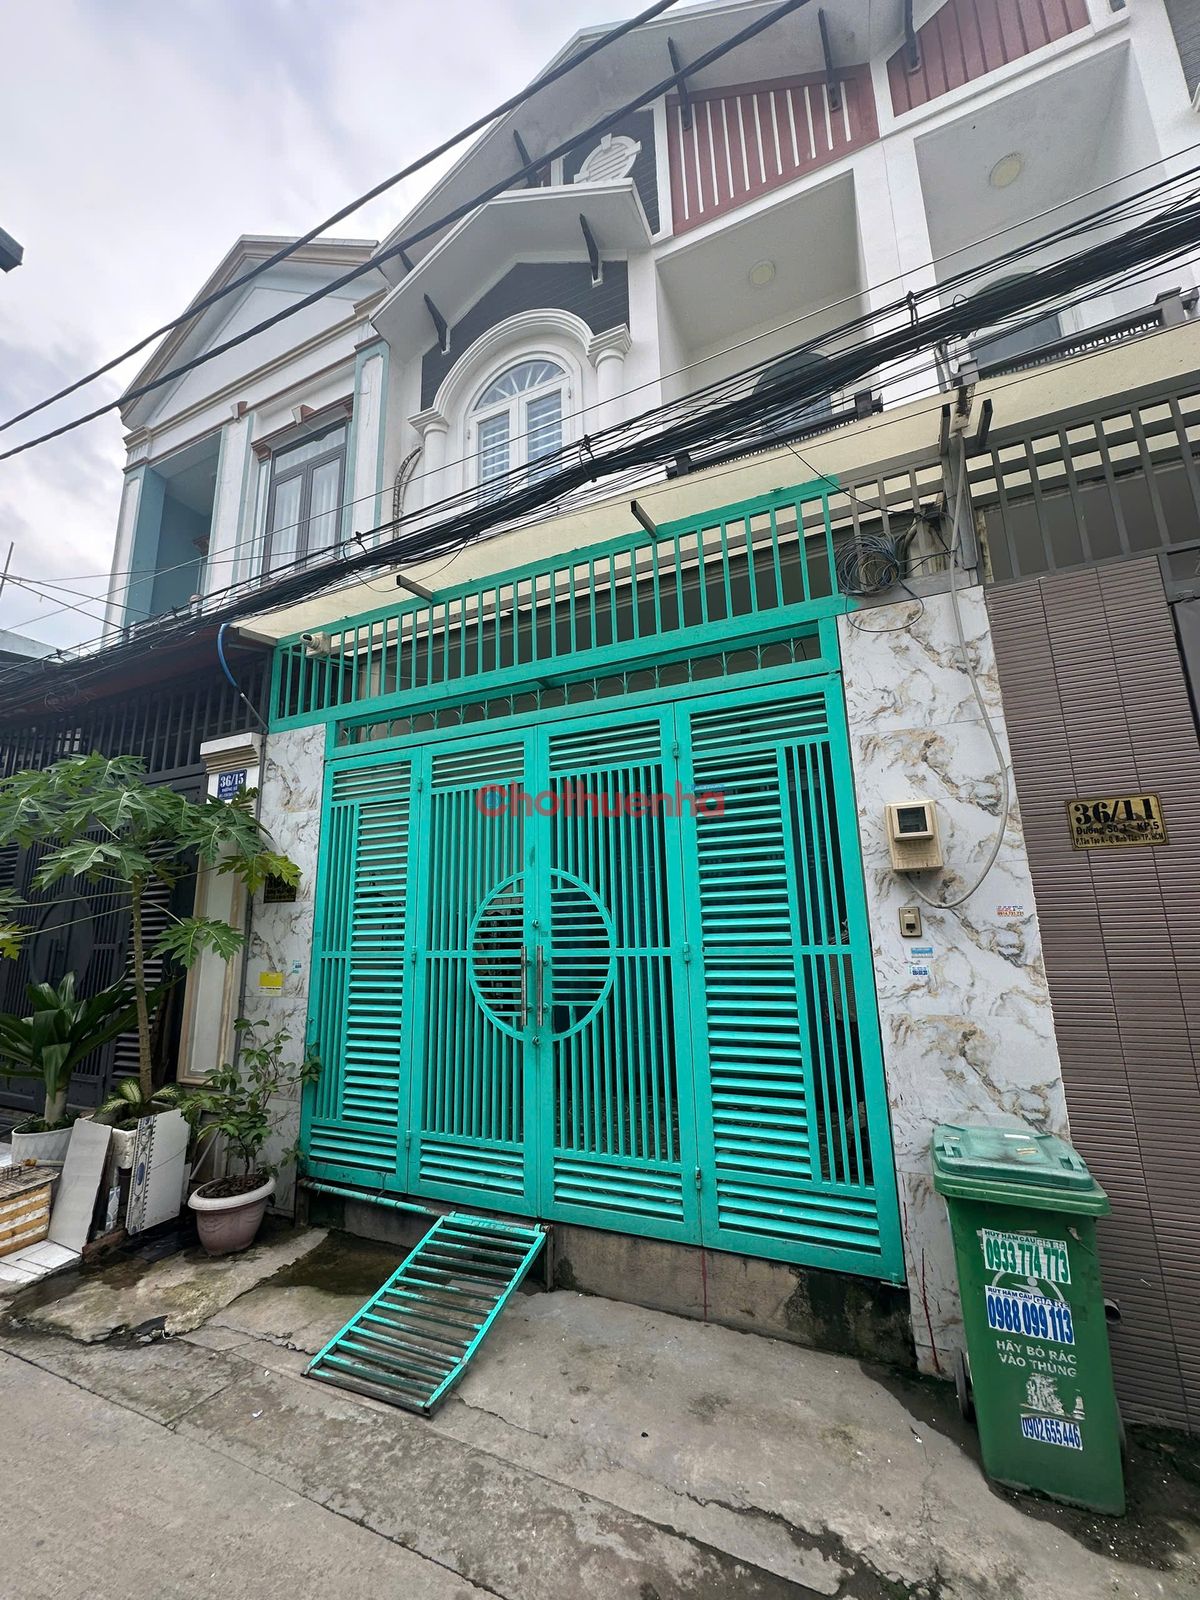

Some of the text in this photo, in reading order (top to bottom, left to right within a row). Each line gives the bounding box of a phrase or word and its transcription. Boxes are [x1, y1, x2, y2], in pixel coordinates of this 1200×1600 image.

[220, 773, 244, 788] 36/15
[1074, 798, 1155, 825] 36/11
[985, 1238, 1069, 1283] 0933.774.773
[987, 1294, 1074, 1344] 0988.099.113
[996, 1339, 1022, 1353] HÃY
[1048, 1349, 1078, 1365] RÁC
[998, 1352, 1078, 1378] VÀO THÙNG
